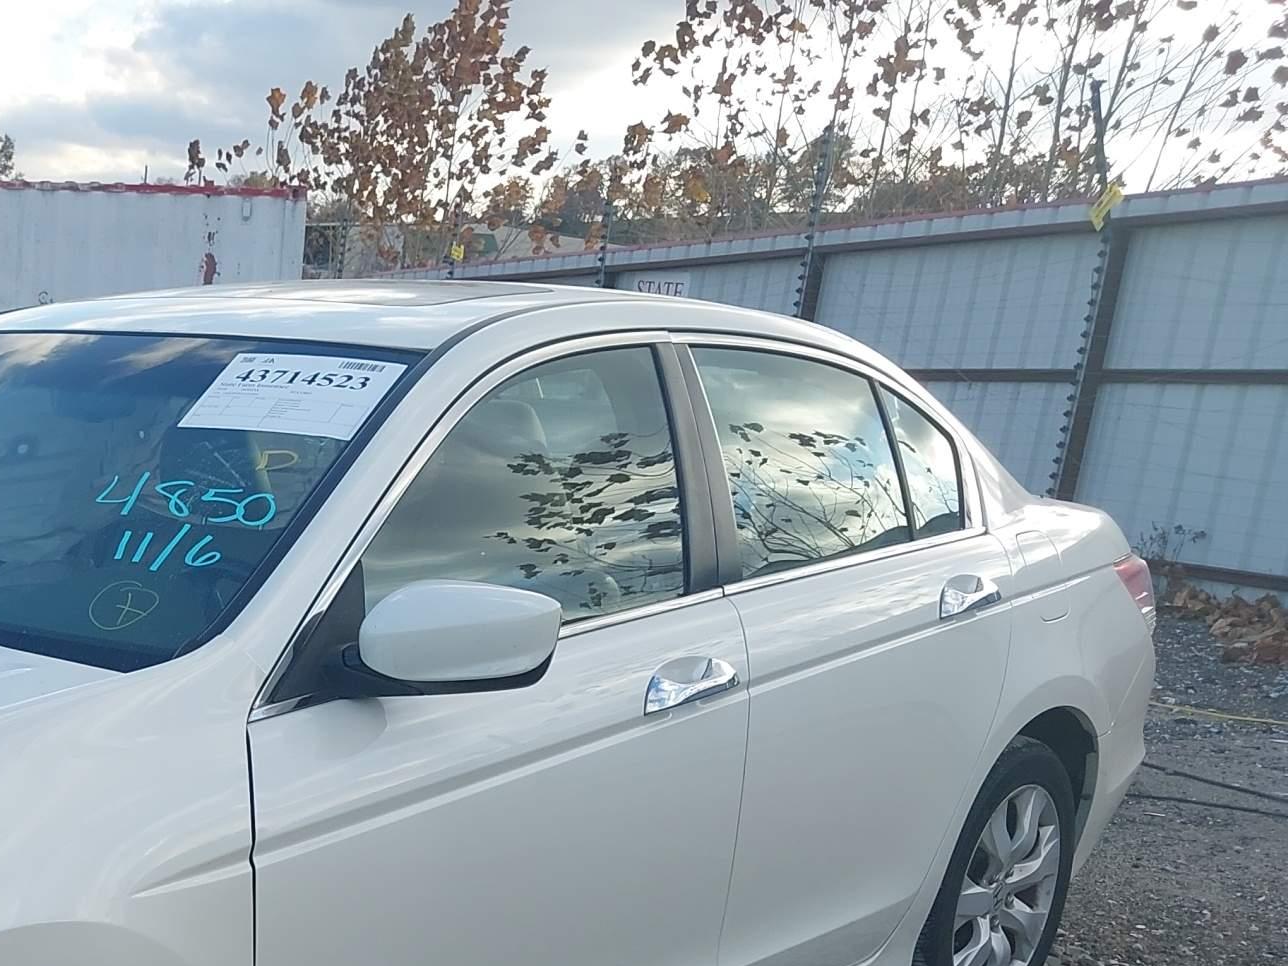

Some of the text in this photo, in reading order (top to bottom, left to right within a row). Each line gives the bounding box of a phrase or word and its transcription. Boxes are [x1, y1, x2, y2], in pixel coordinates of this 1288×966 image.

[637, 280, 684, 296] STATE
[236, 368, 371, 390] 43714523
[95, 471, 277, 526] 4850
[113, 523, 222, 572] 11/6
